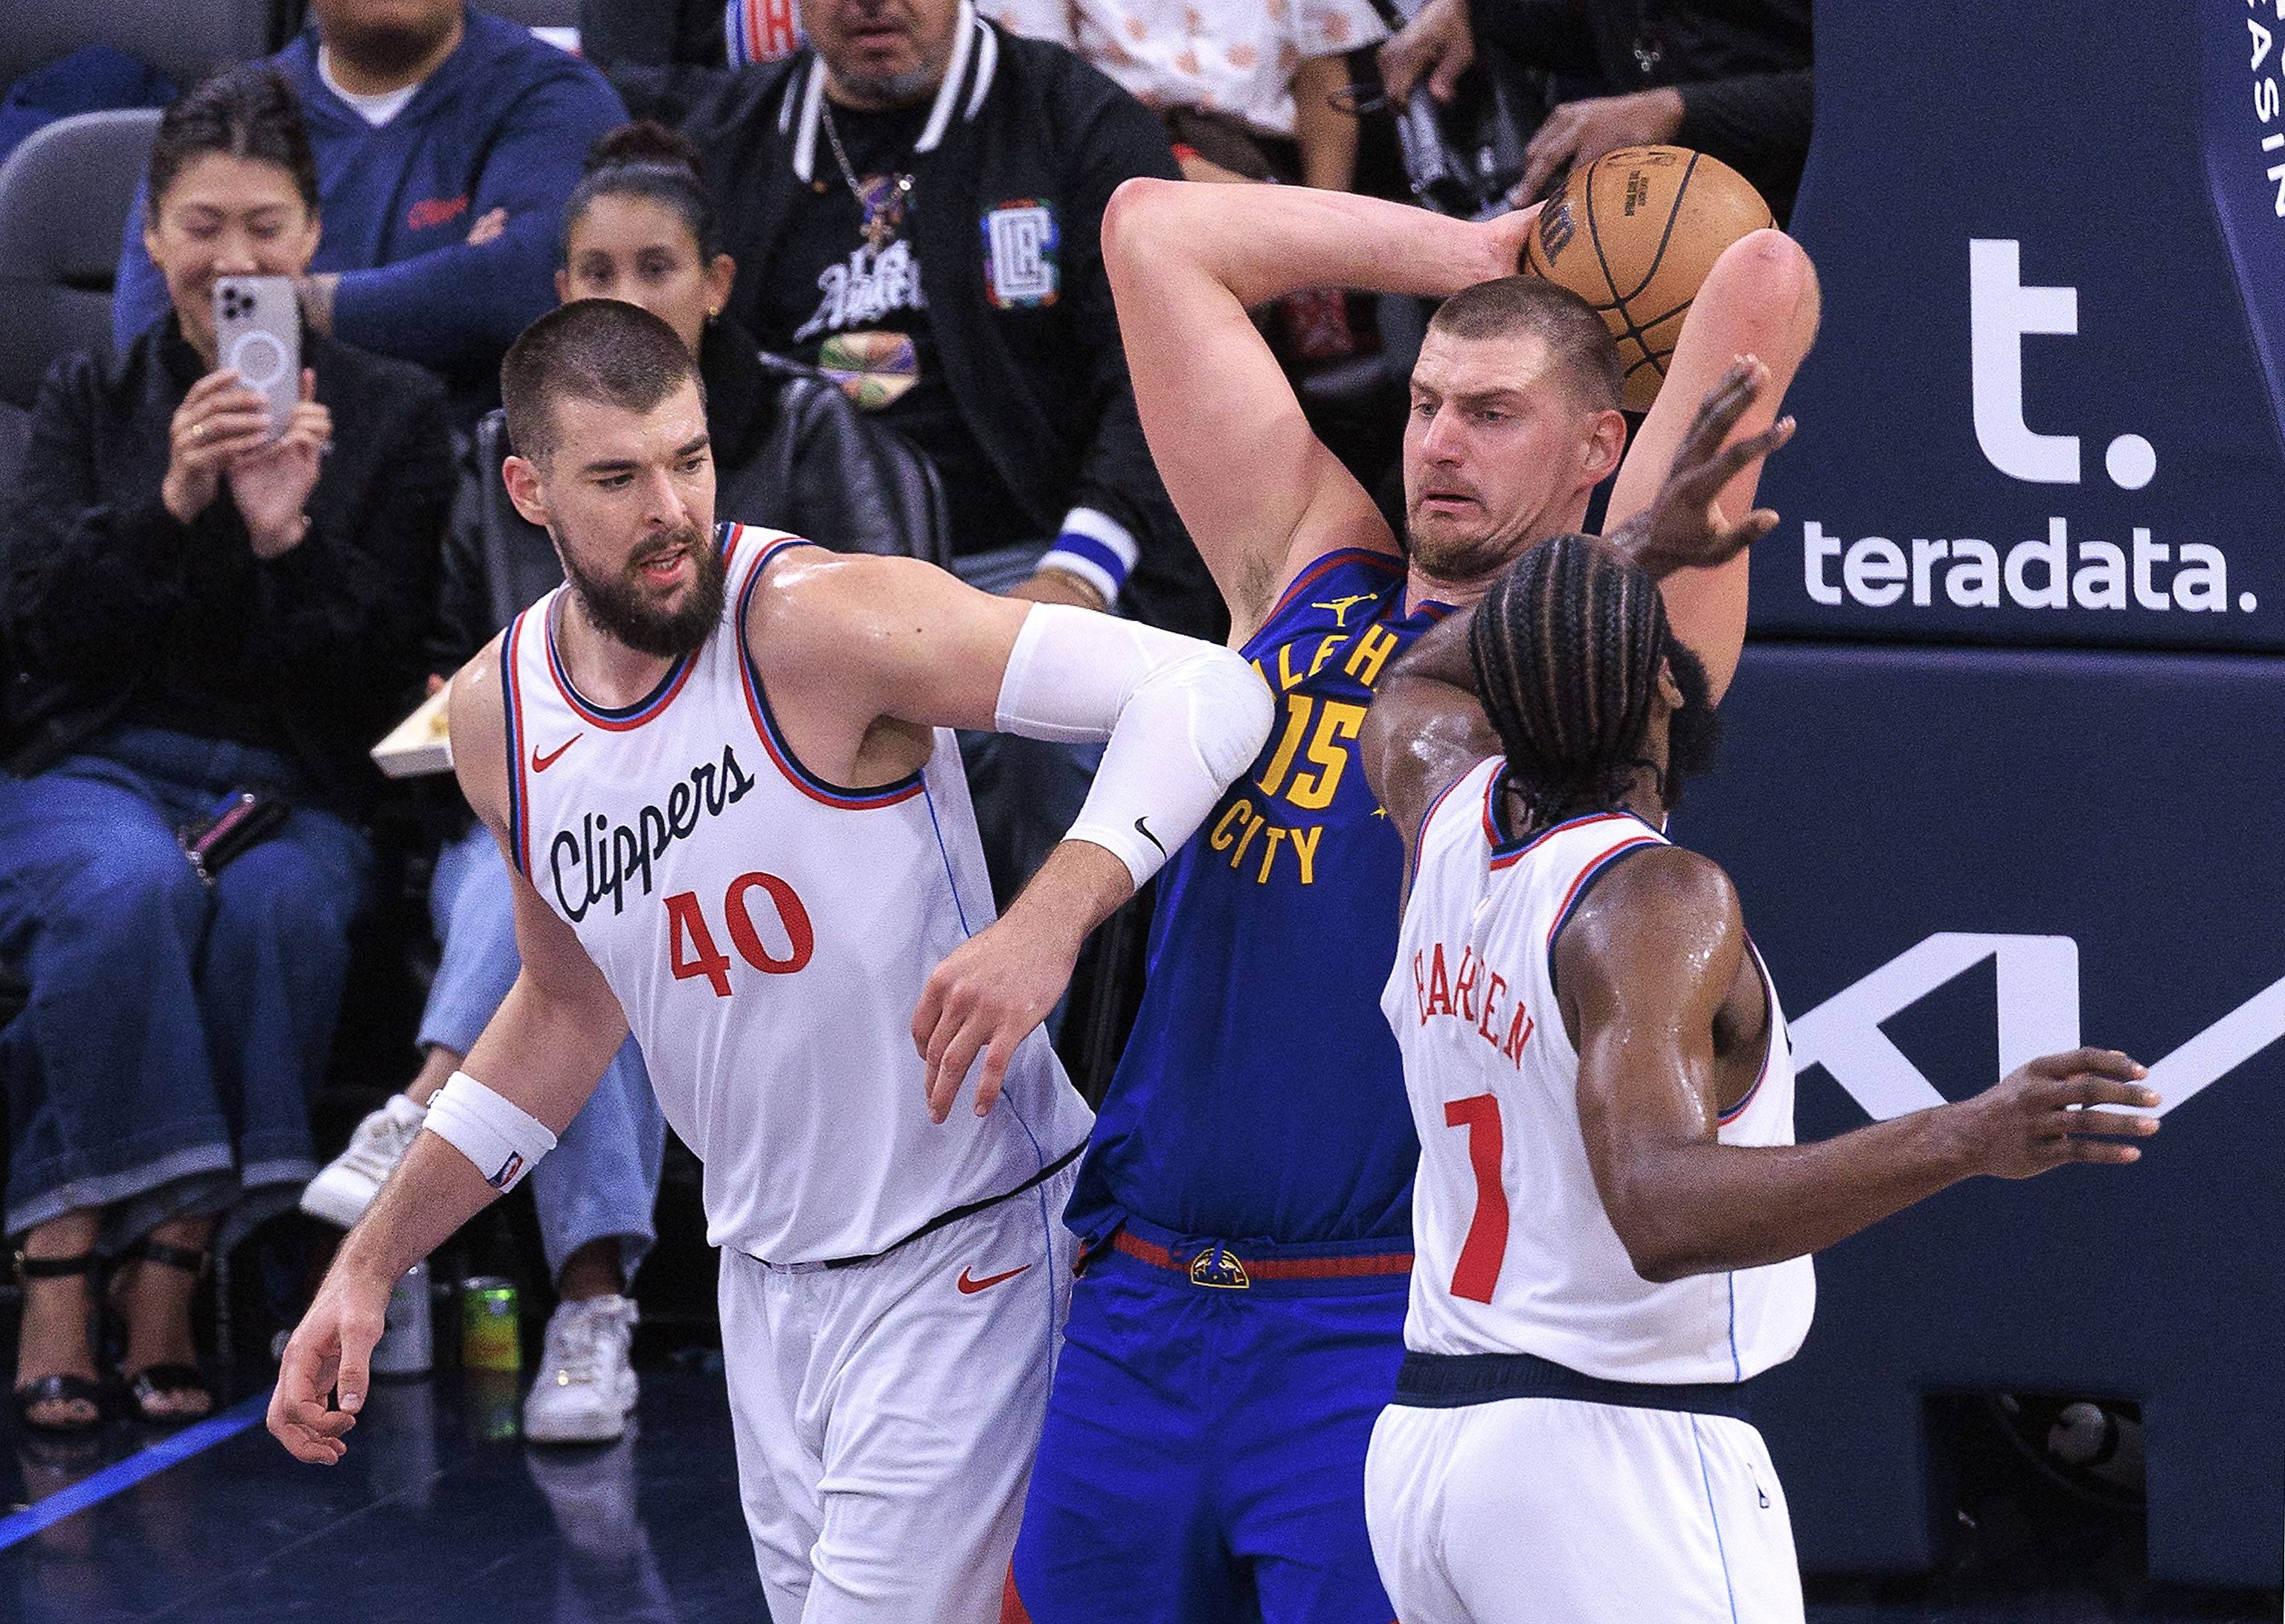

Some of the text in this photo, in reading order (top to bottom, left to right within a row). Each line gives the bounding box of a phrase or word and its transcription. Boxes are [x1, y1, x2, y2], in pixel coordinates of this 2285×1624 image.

[2247, 0, 2285, 218] ASIN
[1803, 516, 2257, 613] teradata.
[1256, 693, 1368, 810] 15
[550, 744, 756, 924] Clippers
[1209, 798, 1323, 885] CITY
[662, 871, 815, 998] 40
[1444, 1092, 1510, 1304] 7
